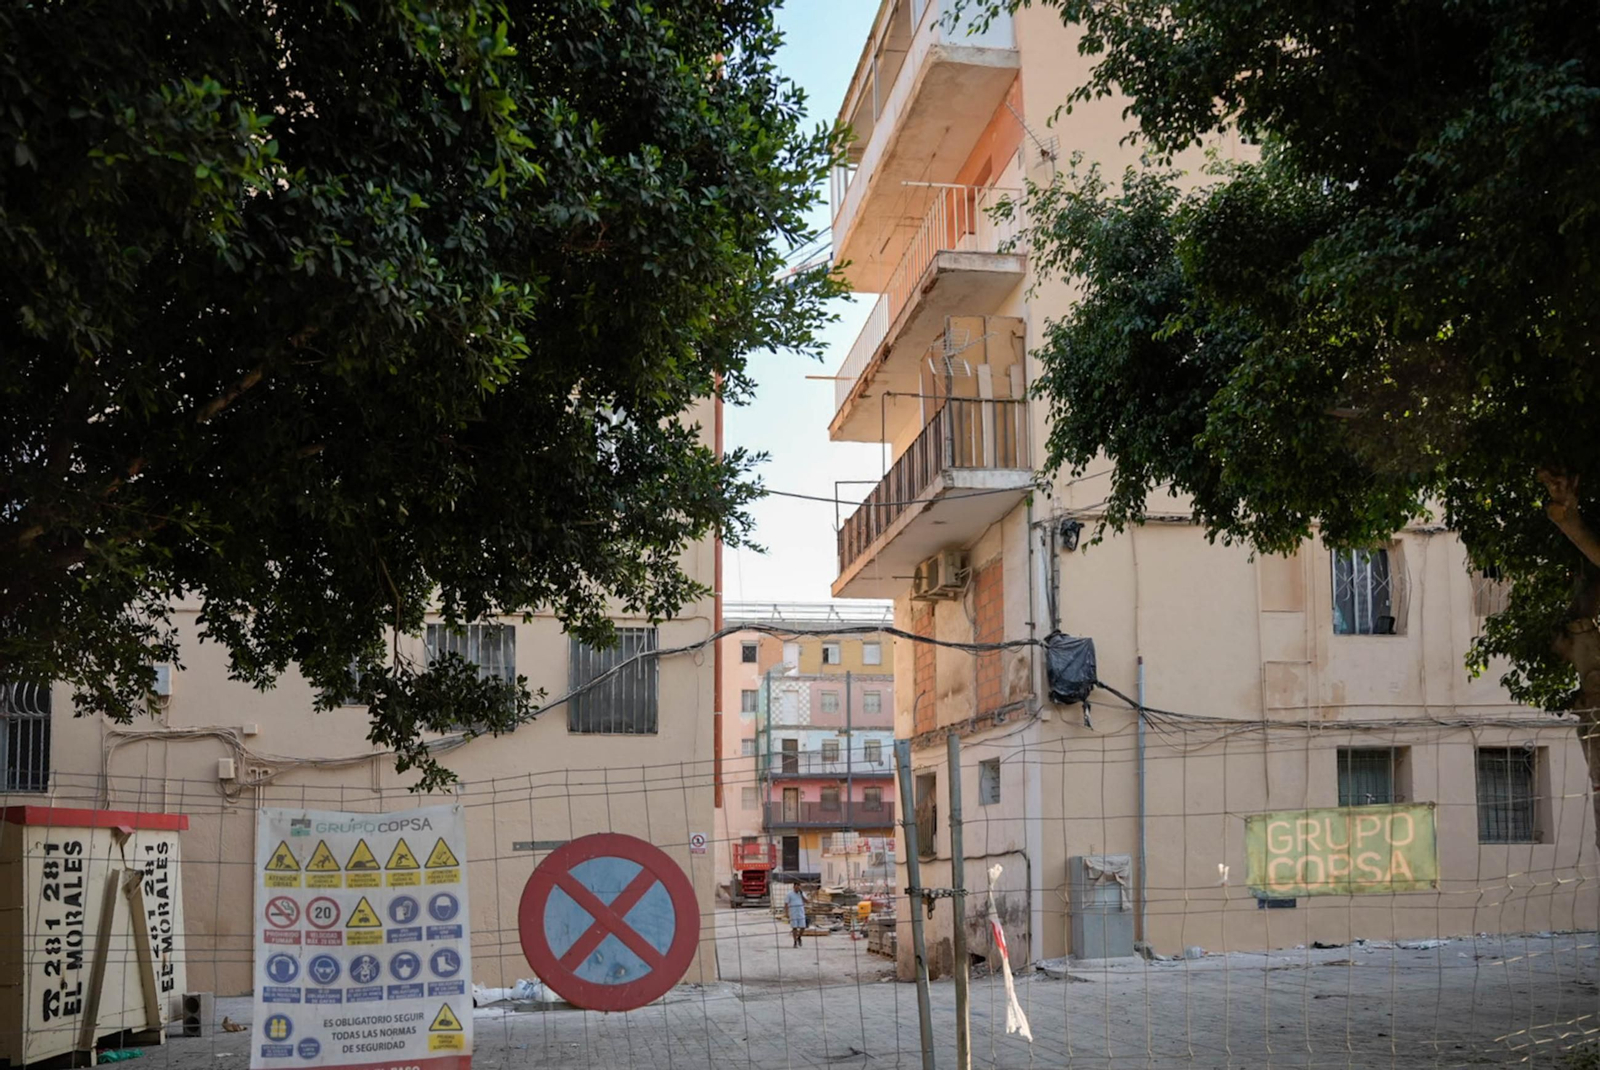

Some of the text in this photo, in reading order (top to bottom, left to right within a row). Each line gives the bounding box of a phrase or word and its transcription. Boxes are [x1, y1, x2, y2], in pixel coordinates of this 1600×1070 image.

[1267, 812, 1414, 854] GRUPO
[1268, 850, 1414, 891] COPSA
[43, 843, 61, 977] 281 281
[63, 840, 84, 1016] EL MORALES
[156, 841, 175, 993] EL MORALES
[315, 906, 332, 919] 20
[323, 1012, 424, 1028] ES OBLIGATORIO SEGUIR
[332, 1025, 417, 1041] TODAS LAS NORMAS
[342, 1040, 406, 1054] DE SEGURIDAD
